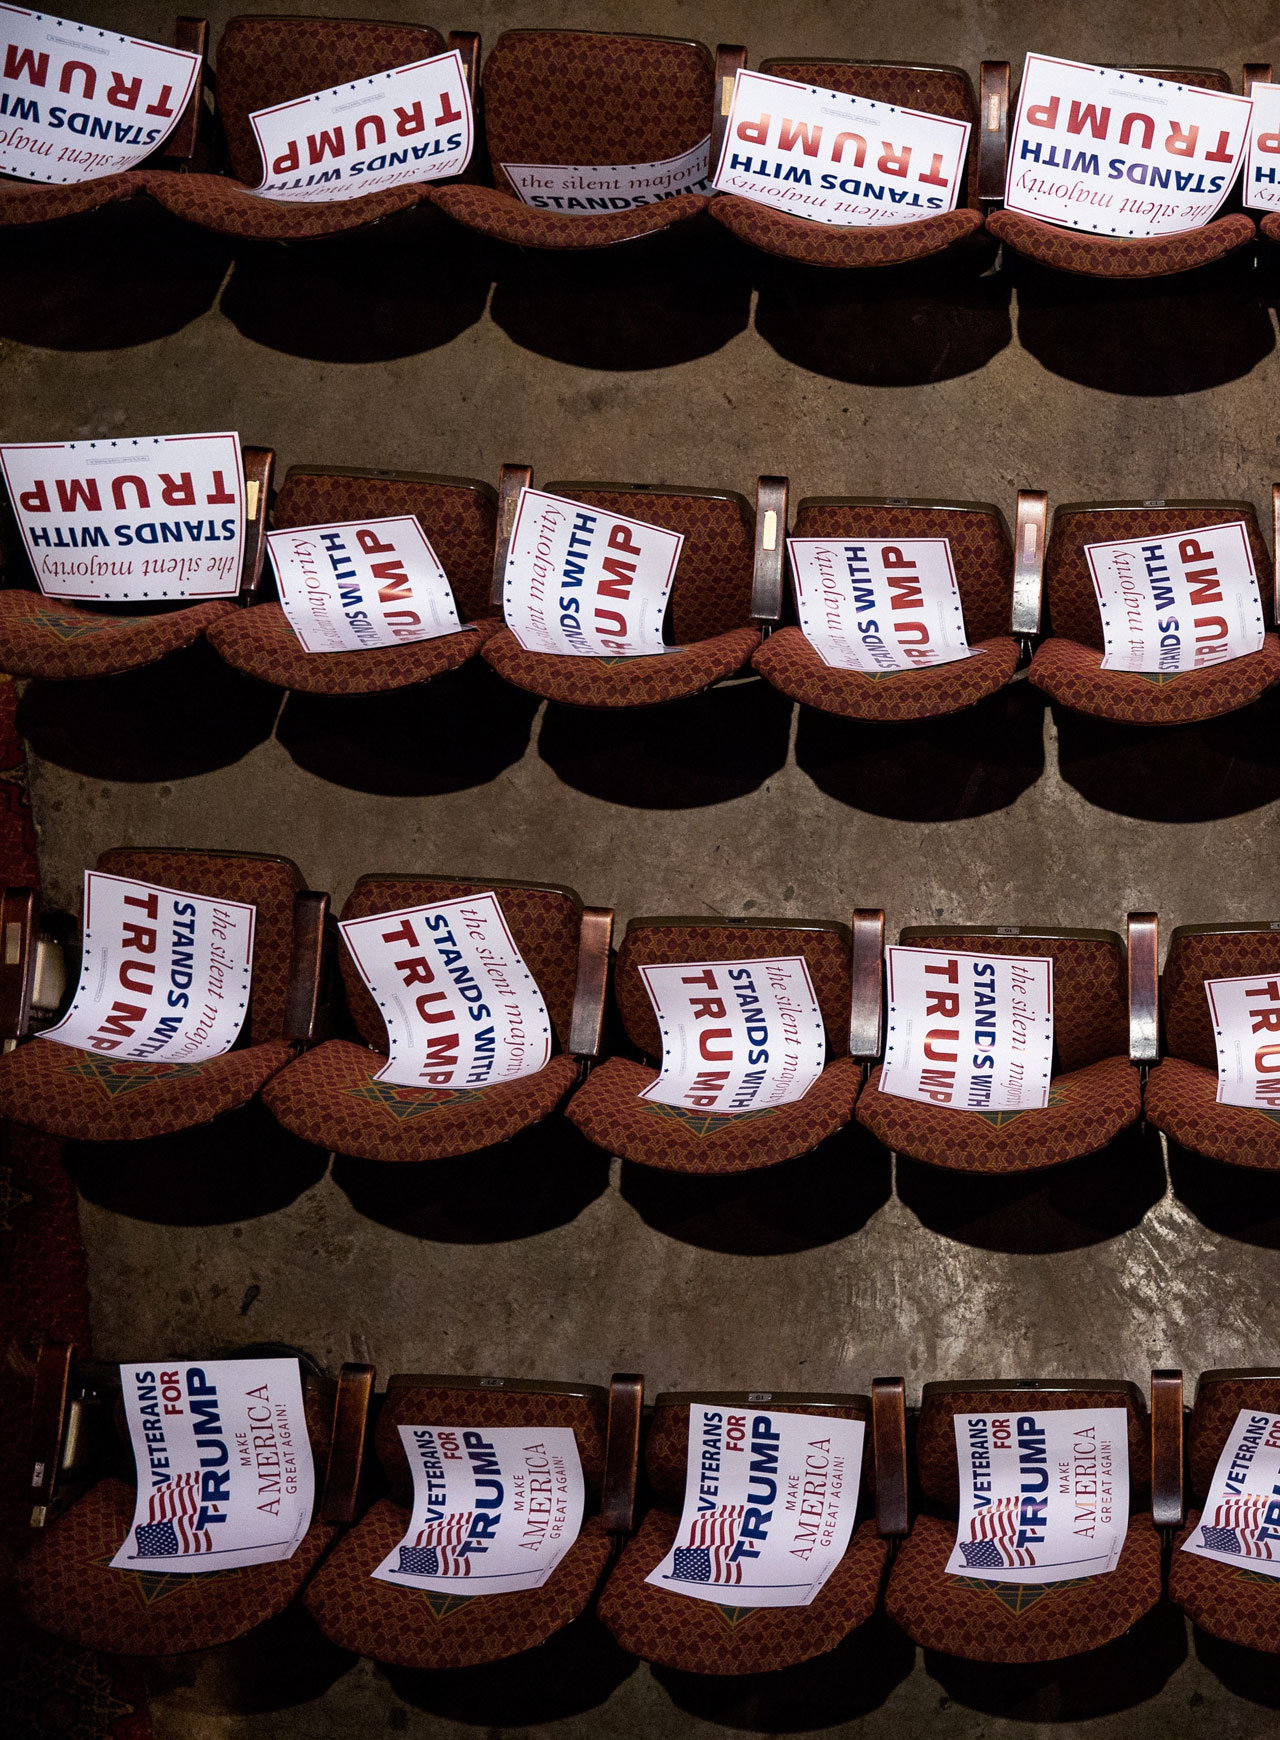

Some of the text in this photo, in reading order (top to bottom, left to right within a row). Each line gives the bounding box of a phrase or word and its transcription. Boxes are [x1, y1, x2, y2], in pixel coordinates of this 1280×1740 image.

[272, 91, 462, 175] TRUMP
[349, 133, 462, 176] STANDS
[736, 113, 949, 188] TRUMP
[1020, 139, 1226, 193] STANDS WITH
[521, 174, 620, 190] the silent
[725, 175, 828, 207] majority
[820, 174, 943, 209] STANDS
[1016, 169, 1179, 223] silent majority
[20, 470, 235, 513] TRUMP
[42, 554, 235, 584] the silent majority
[114, 519, 235, 545] STANDS
[527, 504, 566, 601] majority
[561, 512, 597, 588] WITH
[810, 546, 846, 630] majority
[844, 547, 876, 614] WITH
[1108, 550, 1145, 632] majority
[1178, 538, 1229, 666] TRUMP
[1158, 616, 1181, 670] STANDS
[87, 893, 158, 1051] TRUMP
[126, 900, 196, 1058] STANDS WITH
[208, 907, 236, 999] the silent
[460, 908, 517, 997] the silent
[1011, 965, 1035, 994] the
[425, 914, 496, 1084] STANDS WITH
[765, 966, 802, 1045] the silent
[918, 959, 960, 1103] TRUMP
[973, 962, 996, 1069] STANDS
[728, 968, 769, 1108] STANDS WITH
[135, 1370, 172, 1487] VETERANS
[160, 1370, 184, 1415] FOR
[235, 1432, 251, 1466] MAKE
[245, 1384, 280, 1516] AMERICA
[437, 1431, 463, 1460] FOR
[697, 1411, 723, 1512] VETERANS
[725, 1415, 747, 1452] FOR
[968, 1418, 992, 1510] VETERANS
[1222, 1415, 1270, 1498] VETERANS
[283, 1450, 297, 1495] GREAT
[413, 1430, 446, 1523] VETERANS
[456, 1431, 504, 1558] TRUMP
[513, 1474, 525, 1511] MAKE
[728, 1415, 780, 1563] TRUMP
[785, 1475, 800, 1511] MAKE
[788, 1437, 831, 1561] AMERICA
[1016, 1416, 1049, 1548] TRUMP
[1059, 1461, 1070, 1494] MAKE
[1073, 1426, 1097, 1539] AMERICA
[1101, 1480, 1112, 1523] GREAT
[549, 1498, 568, 1539] GREAT
[820, 1502, 839, 1547] GREAT
